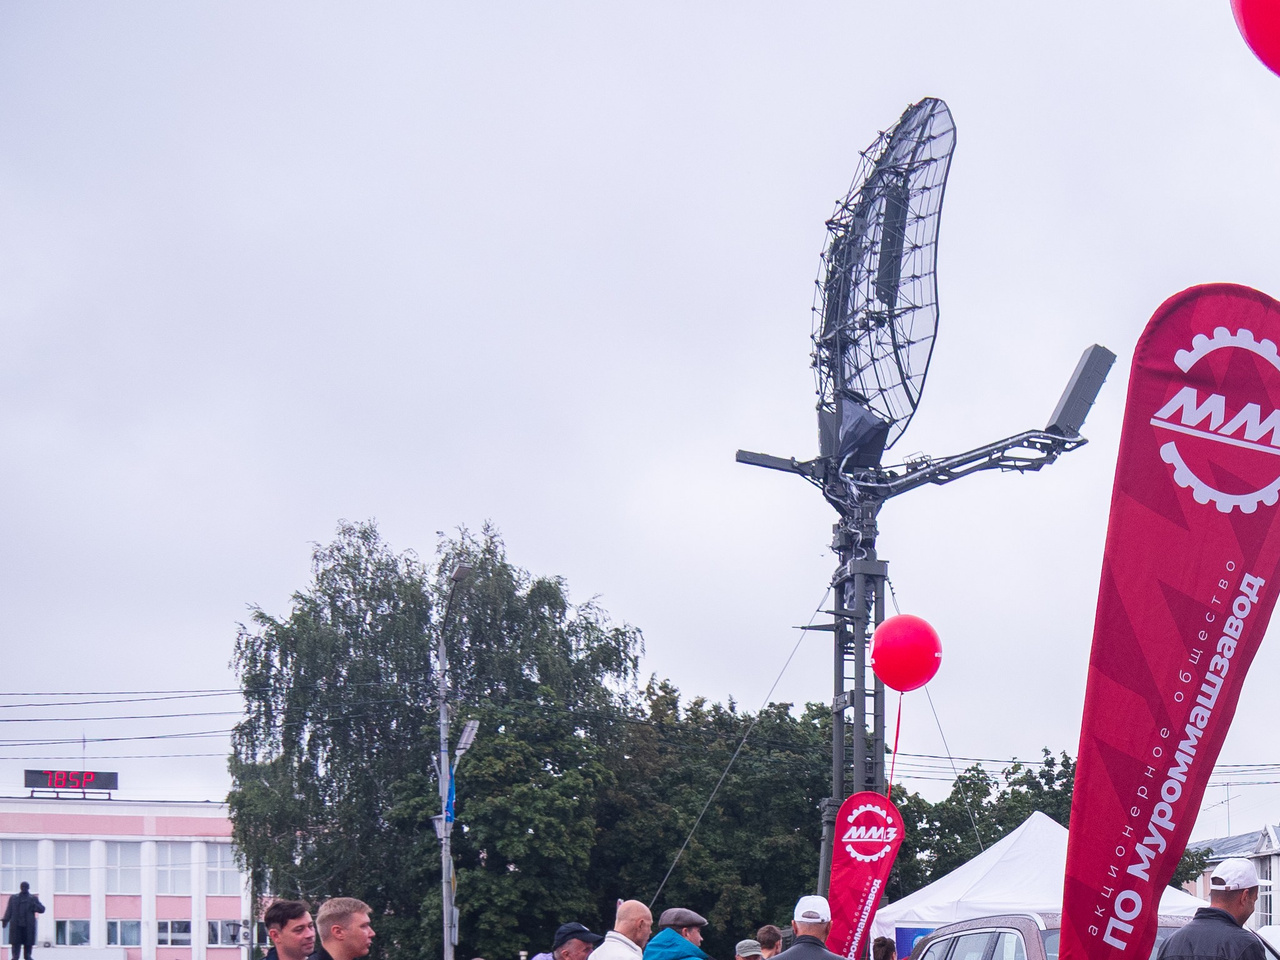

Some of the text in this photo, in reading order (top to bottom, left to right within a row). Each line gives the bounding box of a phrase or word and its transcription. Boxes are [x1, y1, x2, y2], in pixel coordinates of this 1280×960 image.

[1087, 559, 1236, 937] акционерное общество
[1103, 572, 1266, 951] ПО Муроммашзавод
